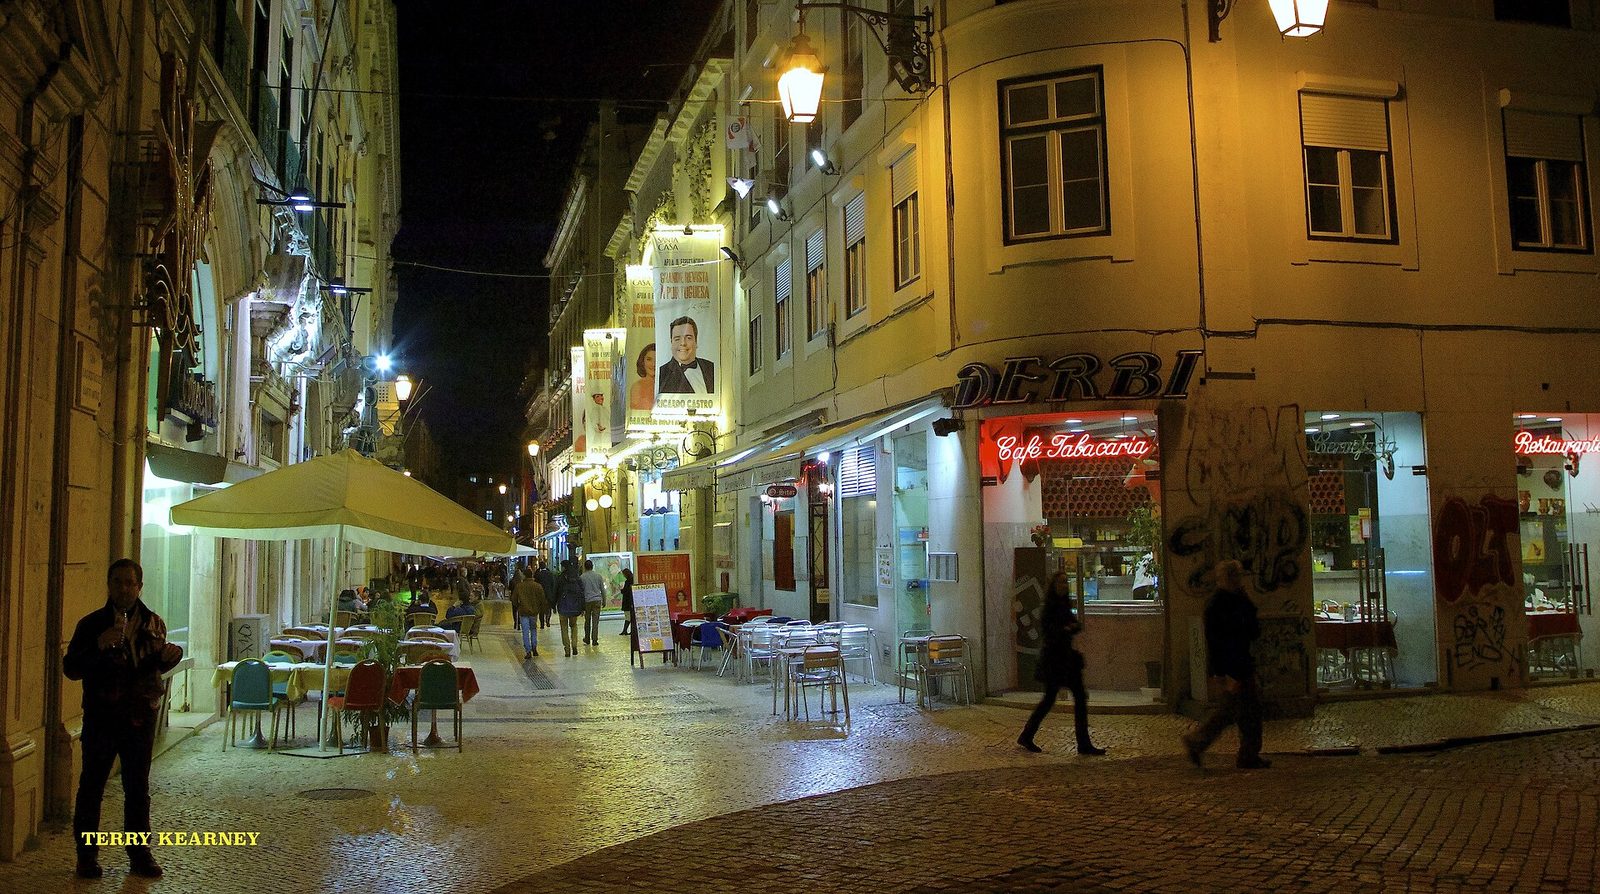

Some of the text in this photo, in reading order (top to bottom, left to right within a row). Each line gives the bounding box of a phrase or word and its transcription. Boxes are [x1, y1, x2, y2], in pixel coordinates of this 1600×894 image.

[685, 271, 709, 283] REVISTA
[951, 350, 1205, 410] DERBI
[686, 399, 714, 409] CASTRO
[997, 433, 1150, 465] Café Tabacaria
